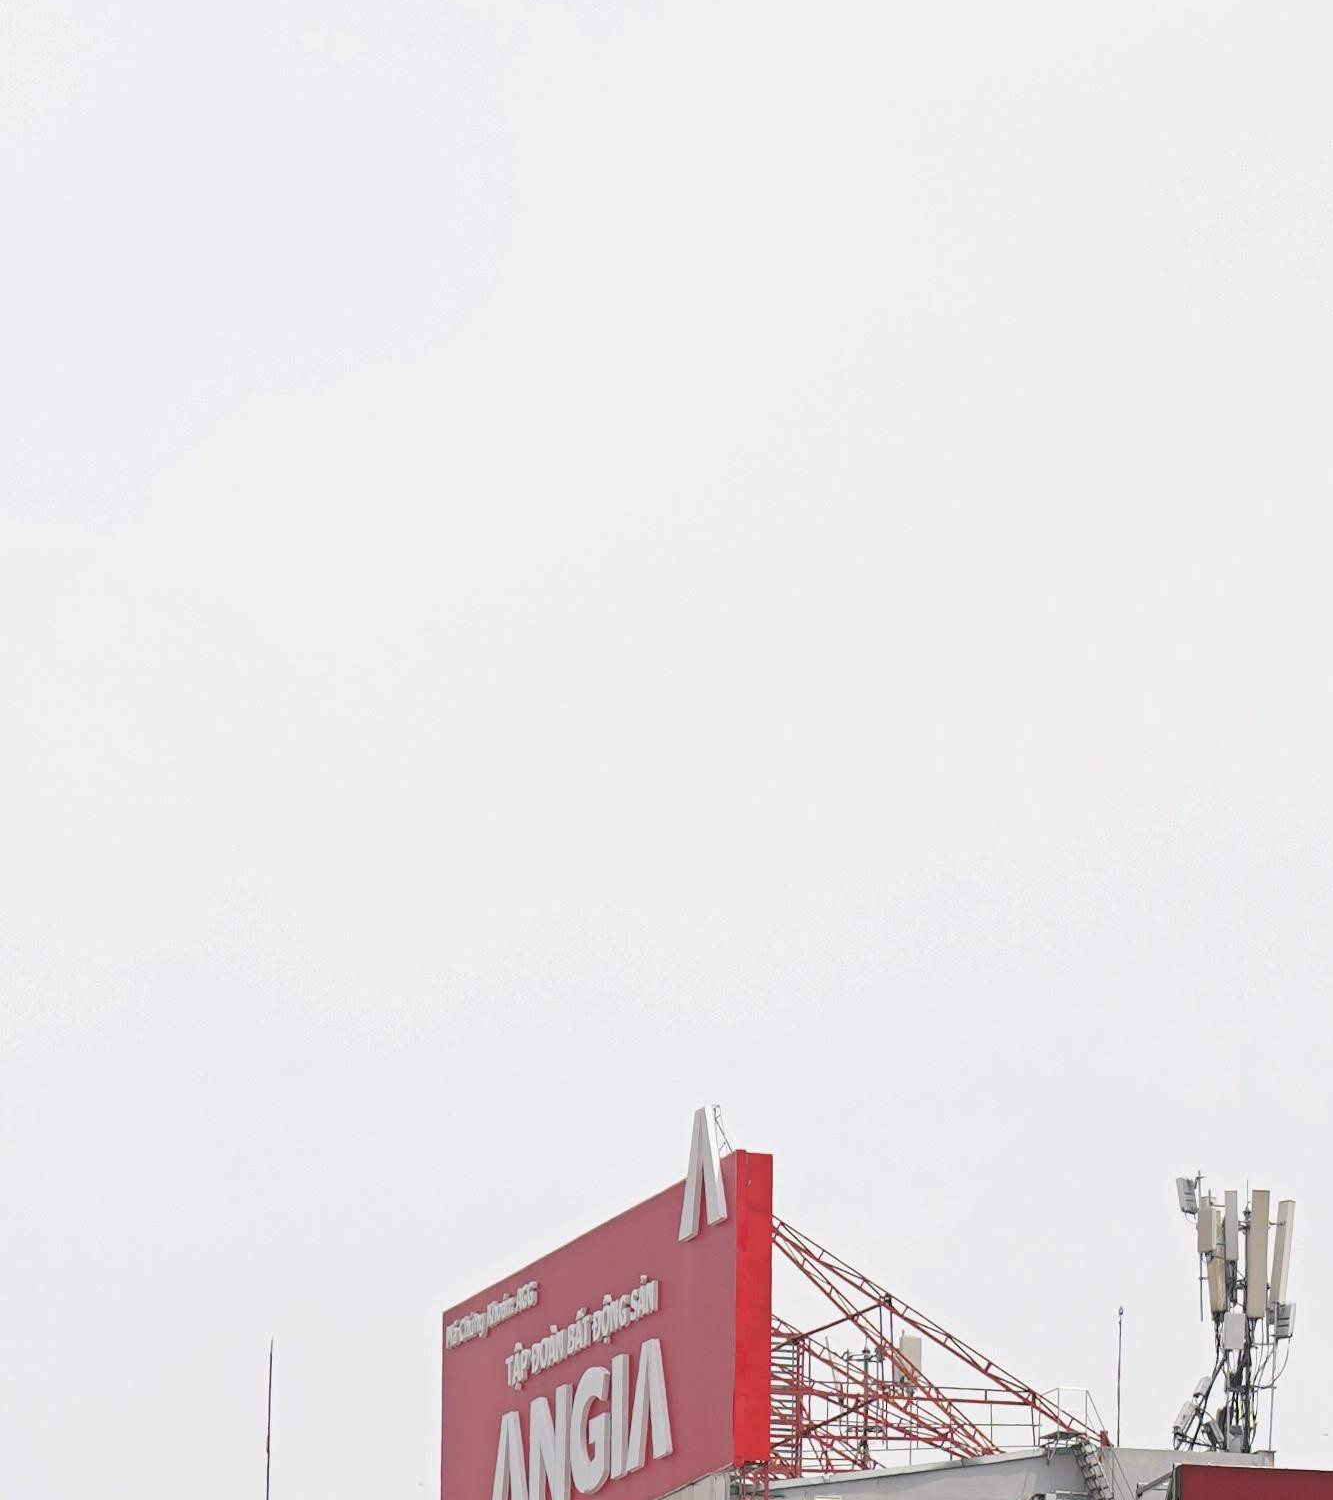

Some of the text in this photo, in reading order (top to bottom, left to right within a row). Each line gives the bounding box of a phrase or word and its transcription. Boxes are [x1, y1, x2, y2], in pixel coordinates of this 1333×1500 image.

[505, 1275, 658, 1391] TẬP ĐOÀN BẤT ĐỘNG SẢN
